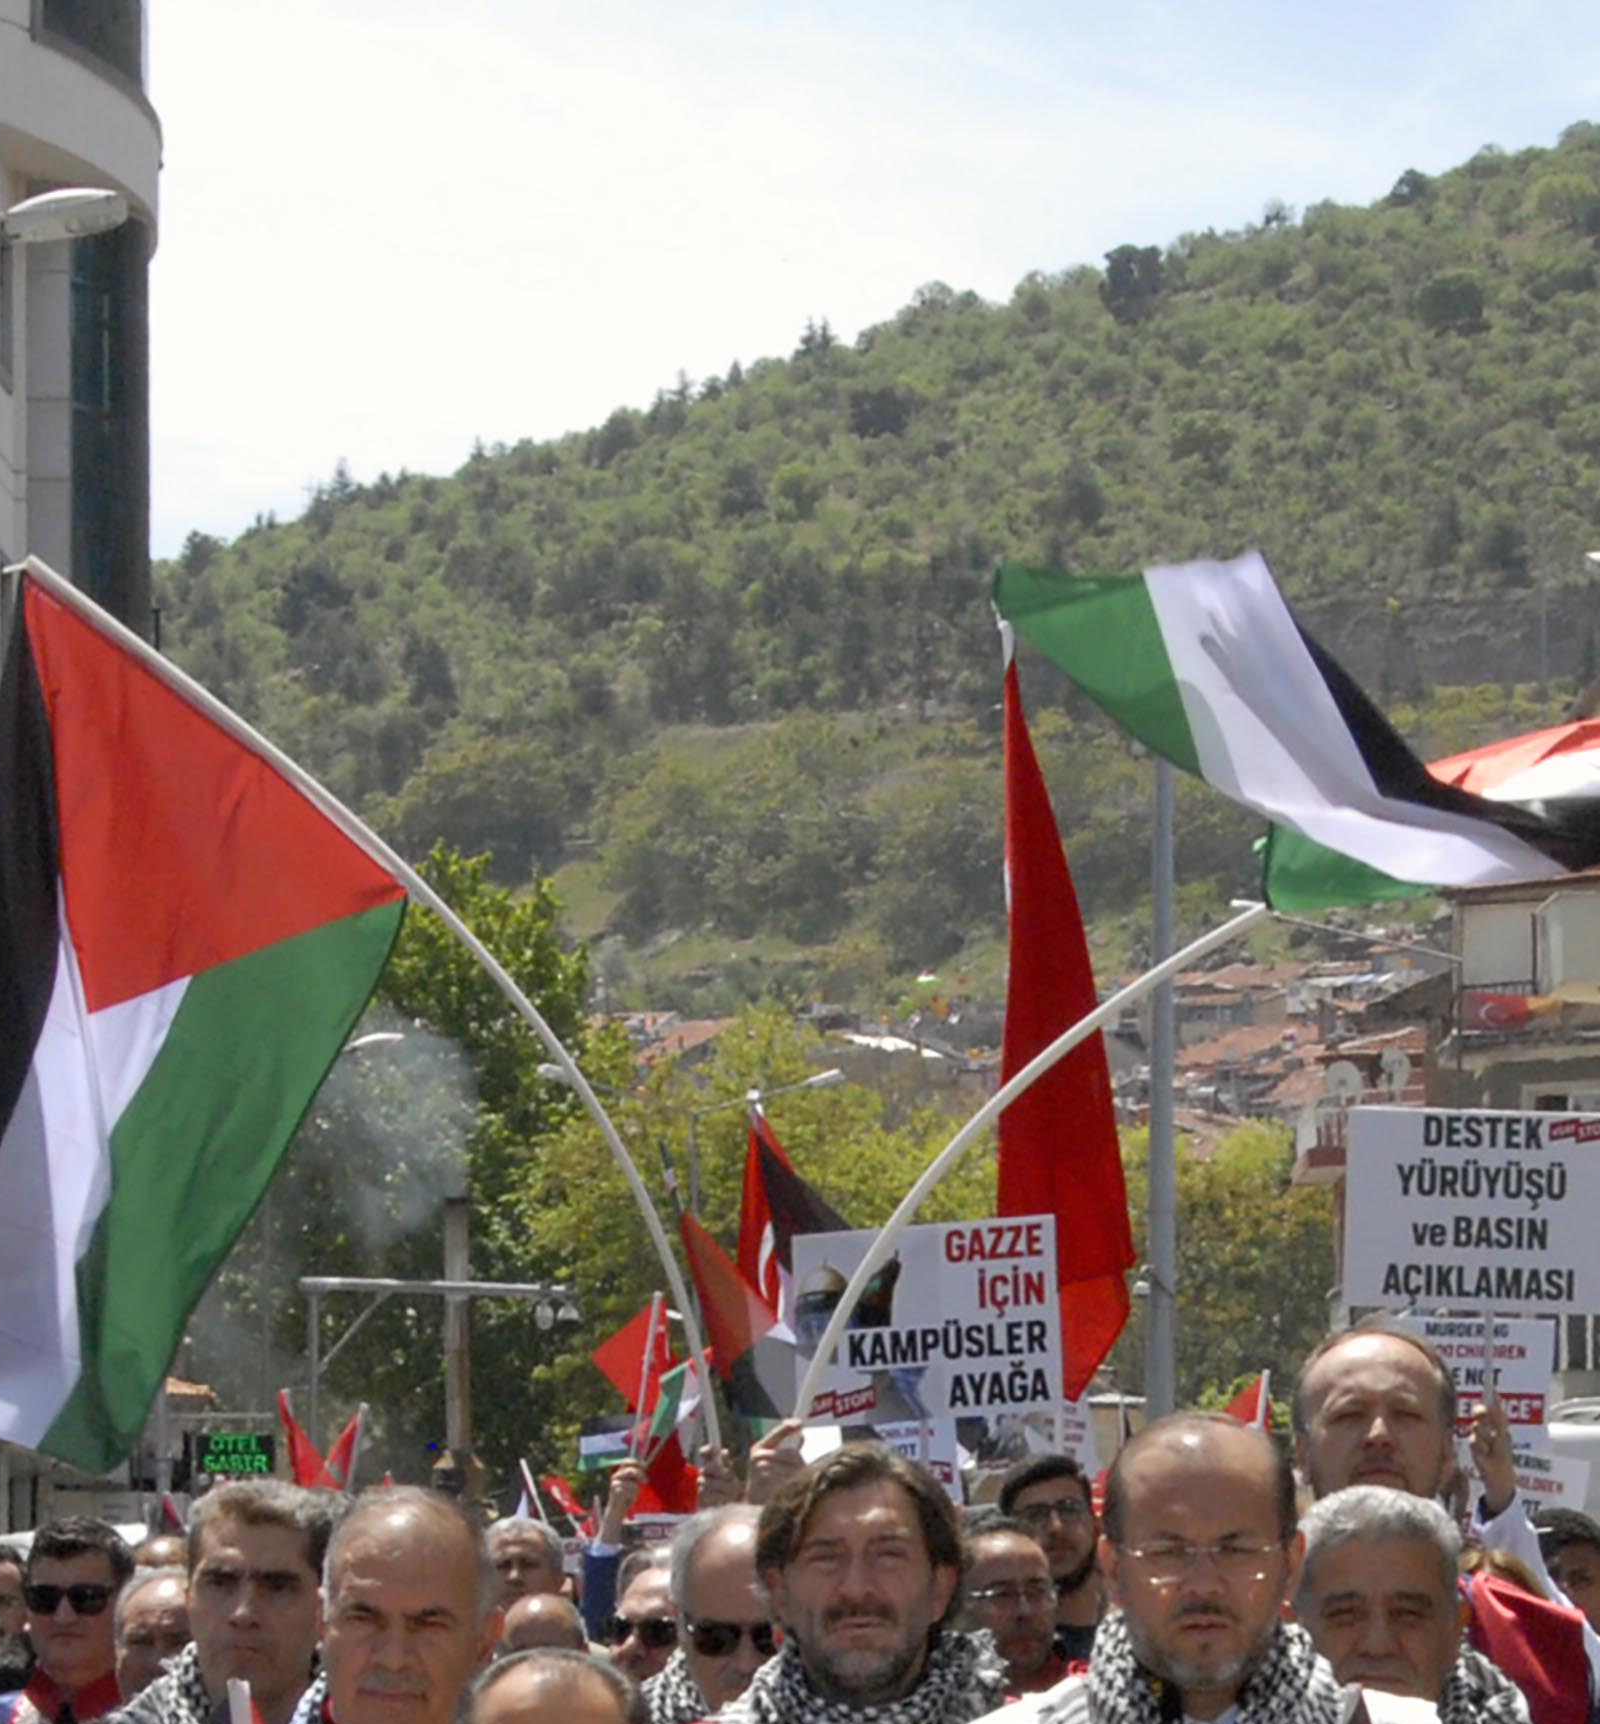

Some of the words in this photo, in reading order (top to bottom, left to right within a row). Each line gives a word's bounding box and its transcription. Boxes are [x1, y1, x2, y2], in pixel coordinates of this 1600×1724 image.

[1423, 1114, 1543, 1150] DESTEK
[1396, 1158, 1567, 1211] YÜRÜYÜŞÜ
[945, 1223, 1044, 1263] GAZZE
[1412, 1222, 1447, 1247] ve
[1453, 1216, 1548, 1251] BASIN
[978, 1264, 1045, 1318] İÇİN
[1382, 1263, 1575, 1306] AÇIKLAMASI
[848, 1319, 1048, 1368] KAMPÜSLER
[1425, 1322, 1509, 1339] MURDERNG
[1456, 1344, 1527, 1359] CHIDREN
[949, 1360, 1051, 1408] AYAĞA
[209, 1436, 258, 1452] OTEL
